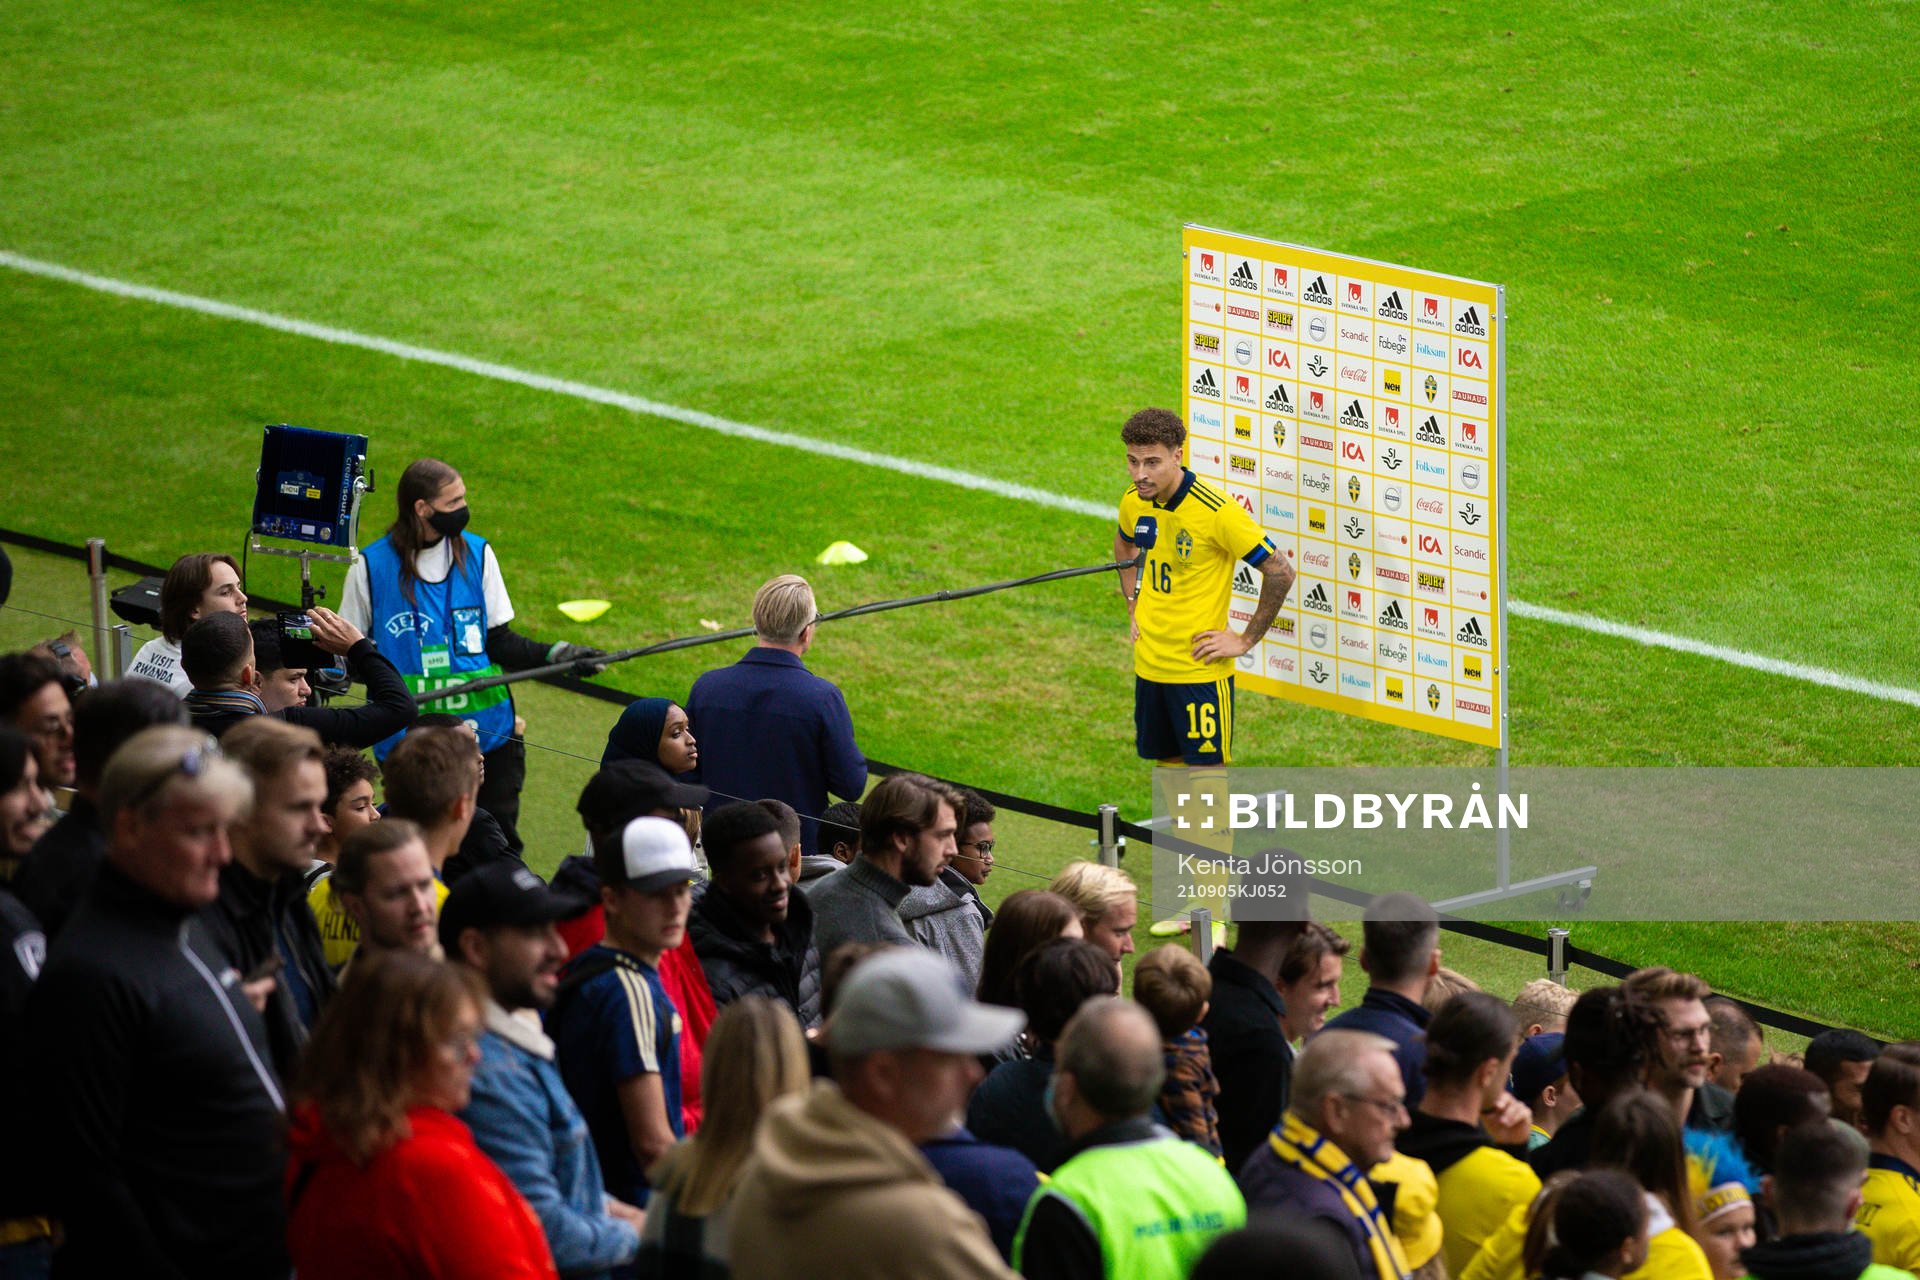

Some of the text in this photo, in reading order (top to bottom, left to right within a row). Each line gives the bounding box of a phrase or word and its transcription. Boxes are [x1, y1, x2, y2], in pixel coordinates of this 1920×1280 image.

[1229, 277, 1258, 290] adidas
[1303, 292, 1332, 306] adidas
[1228, 306, 1259, 320] BAUHAUS
[1267, 310, 1293, 326] SPORT
[1378, 307, 1408, 320] adidas
[1341, 329, 1368, 342] Scandic
[1455, 322, 1485, 336] adidas
[1194, 333, 1220, 350] SPORT
[1379, 336, 1406, 354] Fabege
[1416, 343, 1446, 358] Folksam
[1268, 349, 1290, 369] ICA
[1314, 355, 1322, 366] SJ
[1458, 349, 1482, 369] ICA
[1193, 384, 1220, 398] adidas
[1452, 391, 1487, 405] BAUHAUS
[1265, 400, 1293, 414] adidas
[1194, 412, 1220, 427] Folksam
[1340, 416, 1368, 430] adidas
[1301, 436, 1333, 450] BAUHAUS
[1416, 432, 1445, 445] adidas
[1342, 441, 1365, 462] ICA
[1388, 448, 1396, 458] SJ
[1230, 455, 1255, 472] SPORT
[1416, 460, 1444, 475] Folksam
[1266, 467, 1293, 481] Scandic
[1303, 474, 1330, 493] Fabege
[340, 457, 352, 526] creamsource
[1266, 504, 1293, 519] Folksam
[1466, 503, 1474, 513] SJ
[1350, 517, 1358, 527] SJ
[1419, 535, 1442, 555] ICA
[1454, 546, 1486, 560] Scandic
[1150, 559, 1172, 594] 16
[1376, 568, 1409, 582] BAUHAUS
[1418, 572, 1444, 589] SPORT
[1232, 582, 1258, 596] adidas
[1304, 600, 1332, 613] adidas
[1379, 616, 1408, 630] adidas
[1341, 636, 1368, 650] Scandic
[1457, 632, 1487, 646] adidas
[1379, 644, 1407, 662] Fabege
[1418, 652, 1448, 667] Folksam
[150, 653, 175, 669] VISIT
[134, 662, 173, 684] RWANDA
[1342, 673, 1370, 688] Folksam
[1456, 699, 1490, 715] BAUHAUS
[1186, 703, 1216, 738] 16
